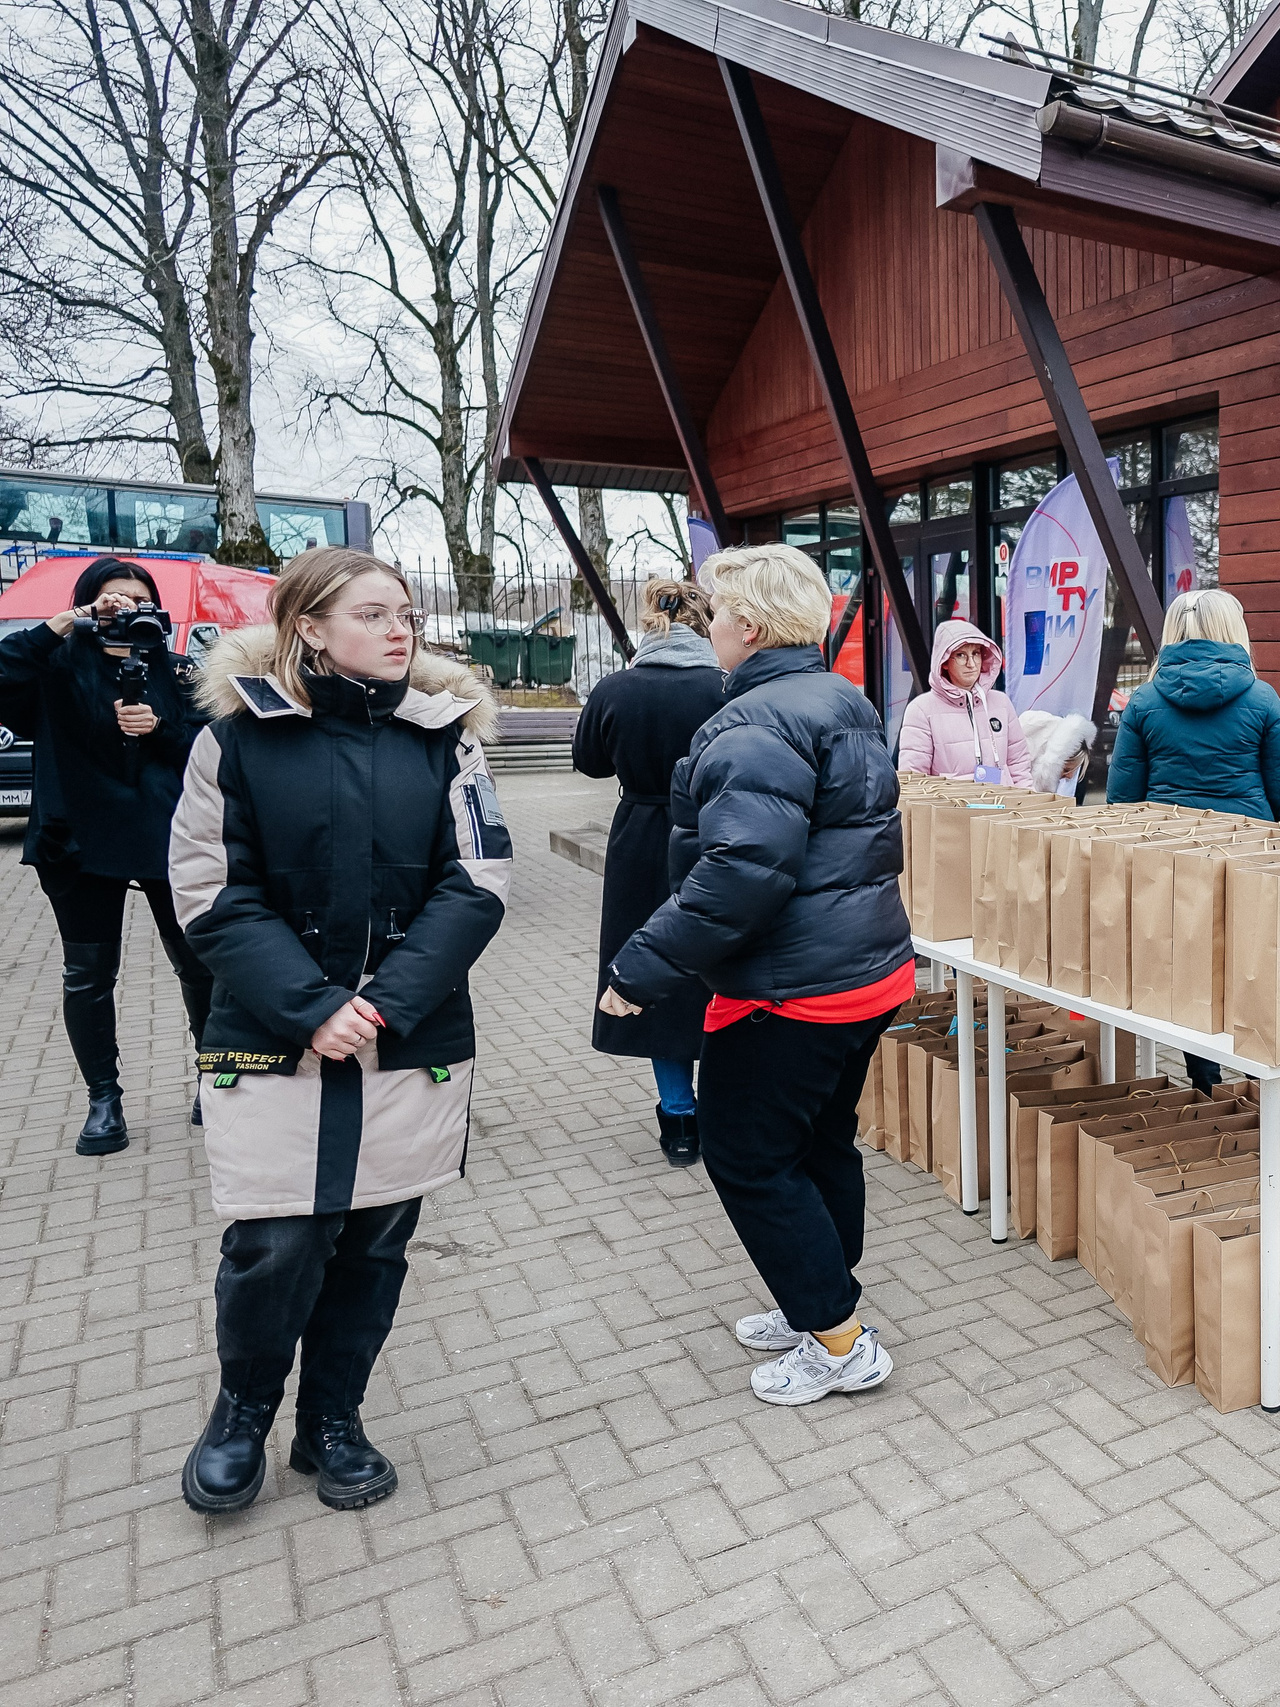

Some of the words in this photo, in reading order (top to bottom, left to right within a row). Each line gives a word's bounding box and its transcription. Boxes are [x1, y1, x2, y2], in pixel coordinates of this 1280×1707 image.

[200, 1052, 225, 1063] ERFECT
[227, 1051, 287, 1064] PERFECT
[235, 1062, 269, 1070] FASHION
